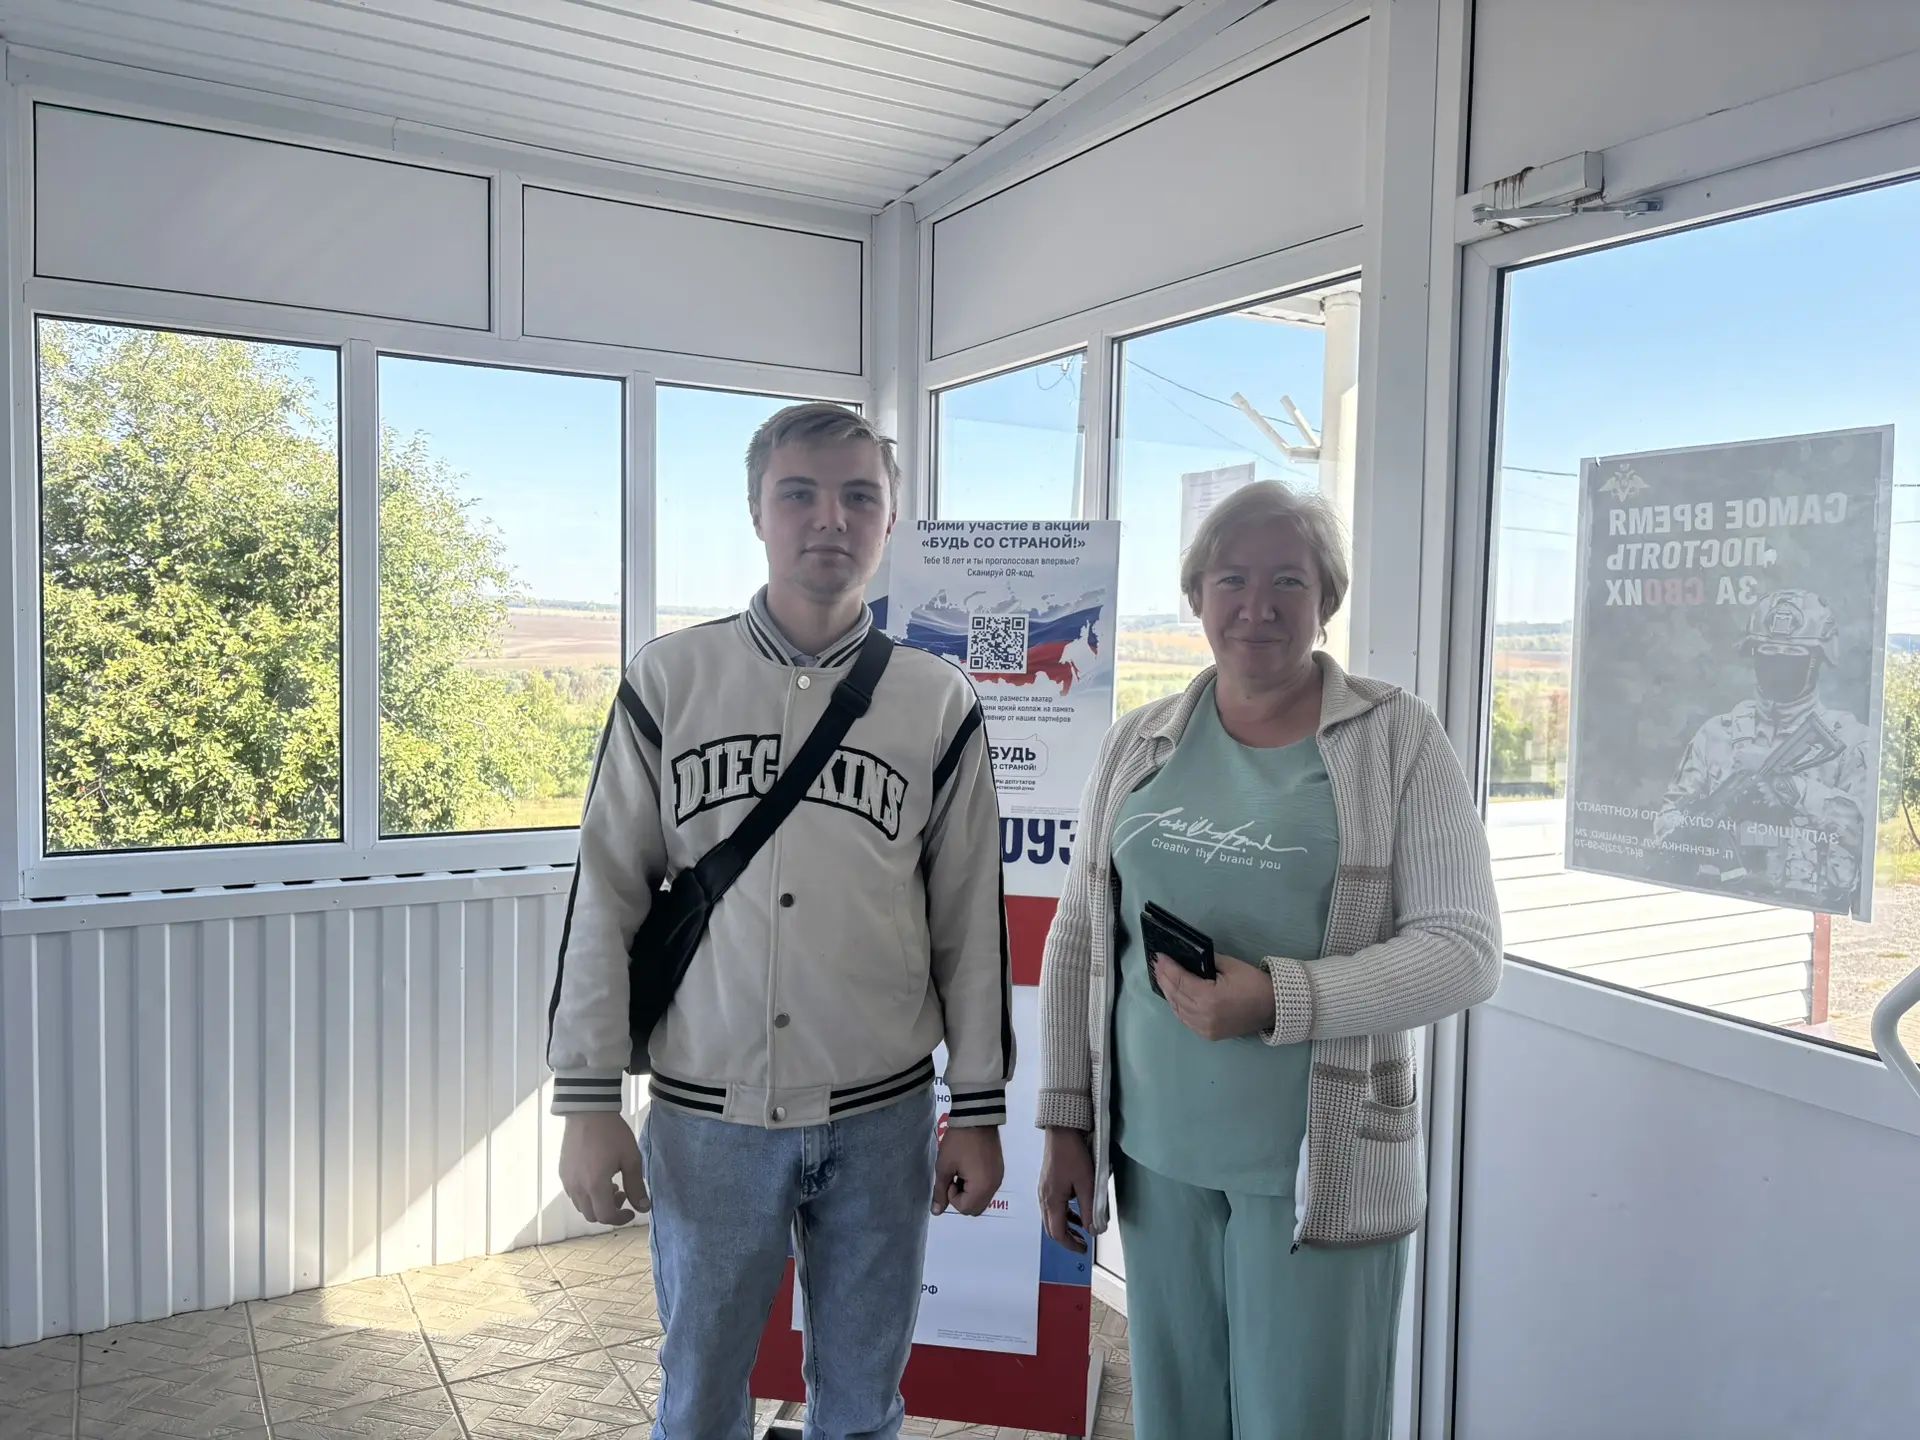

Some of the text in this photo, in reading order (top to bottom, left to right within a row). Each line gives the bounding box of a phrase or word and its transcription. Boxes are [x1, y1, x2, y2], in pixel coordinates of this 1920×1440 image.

[917, 521, 1090, 533] Прими участие в акции
[921, 534, 1086, 550] «БУДЬ СО СТРАНОЙ!»
[923, 556, 941, 565] Тебе
[942, 556, 950, 565] 18
[952, 557, 965, 565] лет
[985, 557, 1039, 567] проголосовал
[1041, 557, 1080, 567] впервые?
[967, 568, 1003, 578] Сканируй
[989, 747, 1036, 763] БУДЬ
[999, 763, 1037, 771] СТРАНОЙ!
[1151, 837, 1189, 855] Creativ
[1220, 852, 1254, 867] brand
[1260, 858, 1281, 871] you
